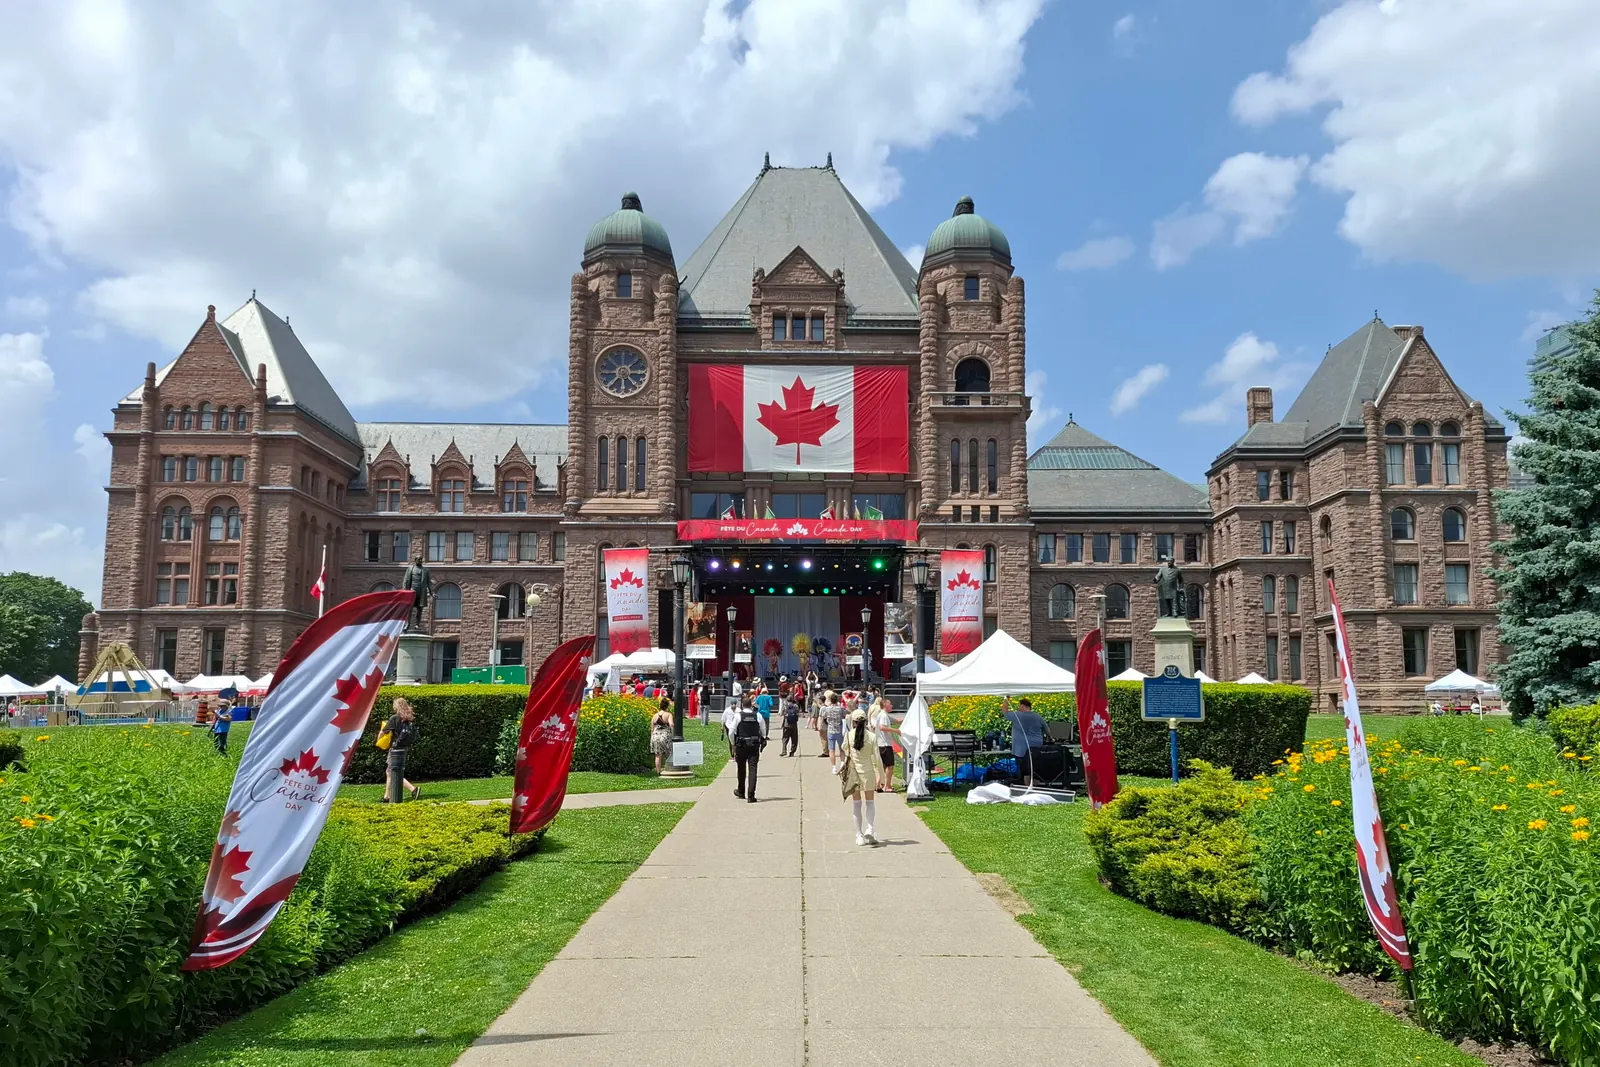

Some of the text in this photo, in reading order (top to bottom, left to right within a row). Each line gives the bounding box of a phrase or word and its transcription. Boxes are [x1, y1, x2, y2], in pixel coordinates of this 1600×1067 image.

[720, 524, 735, 532] FÊTE
[746, 522, 781, 536] Canada
[813, 522, 848, 536] Canada
[609, 593, 645, 611] Canada
[943, 595, 981, 611] Canada
[283, 778, 318, 792] FÊTE DU
[285, 802, 303, 812] DAY
